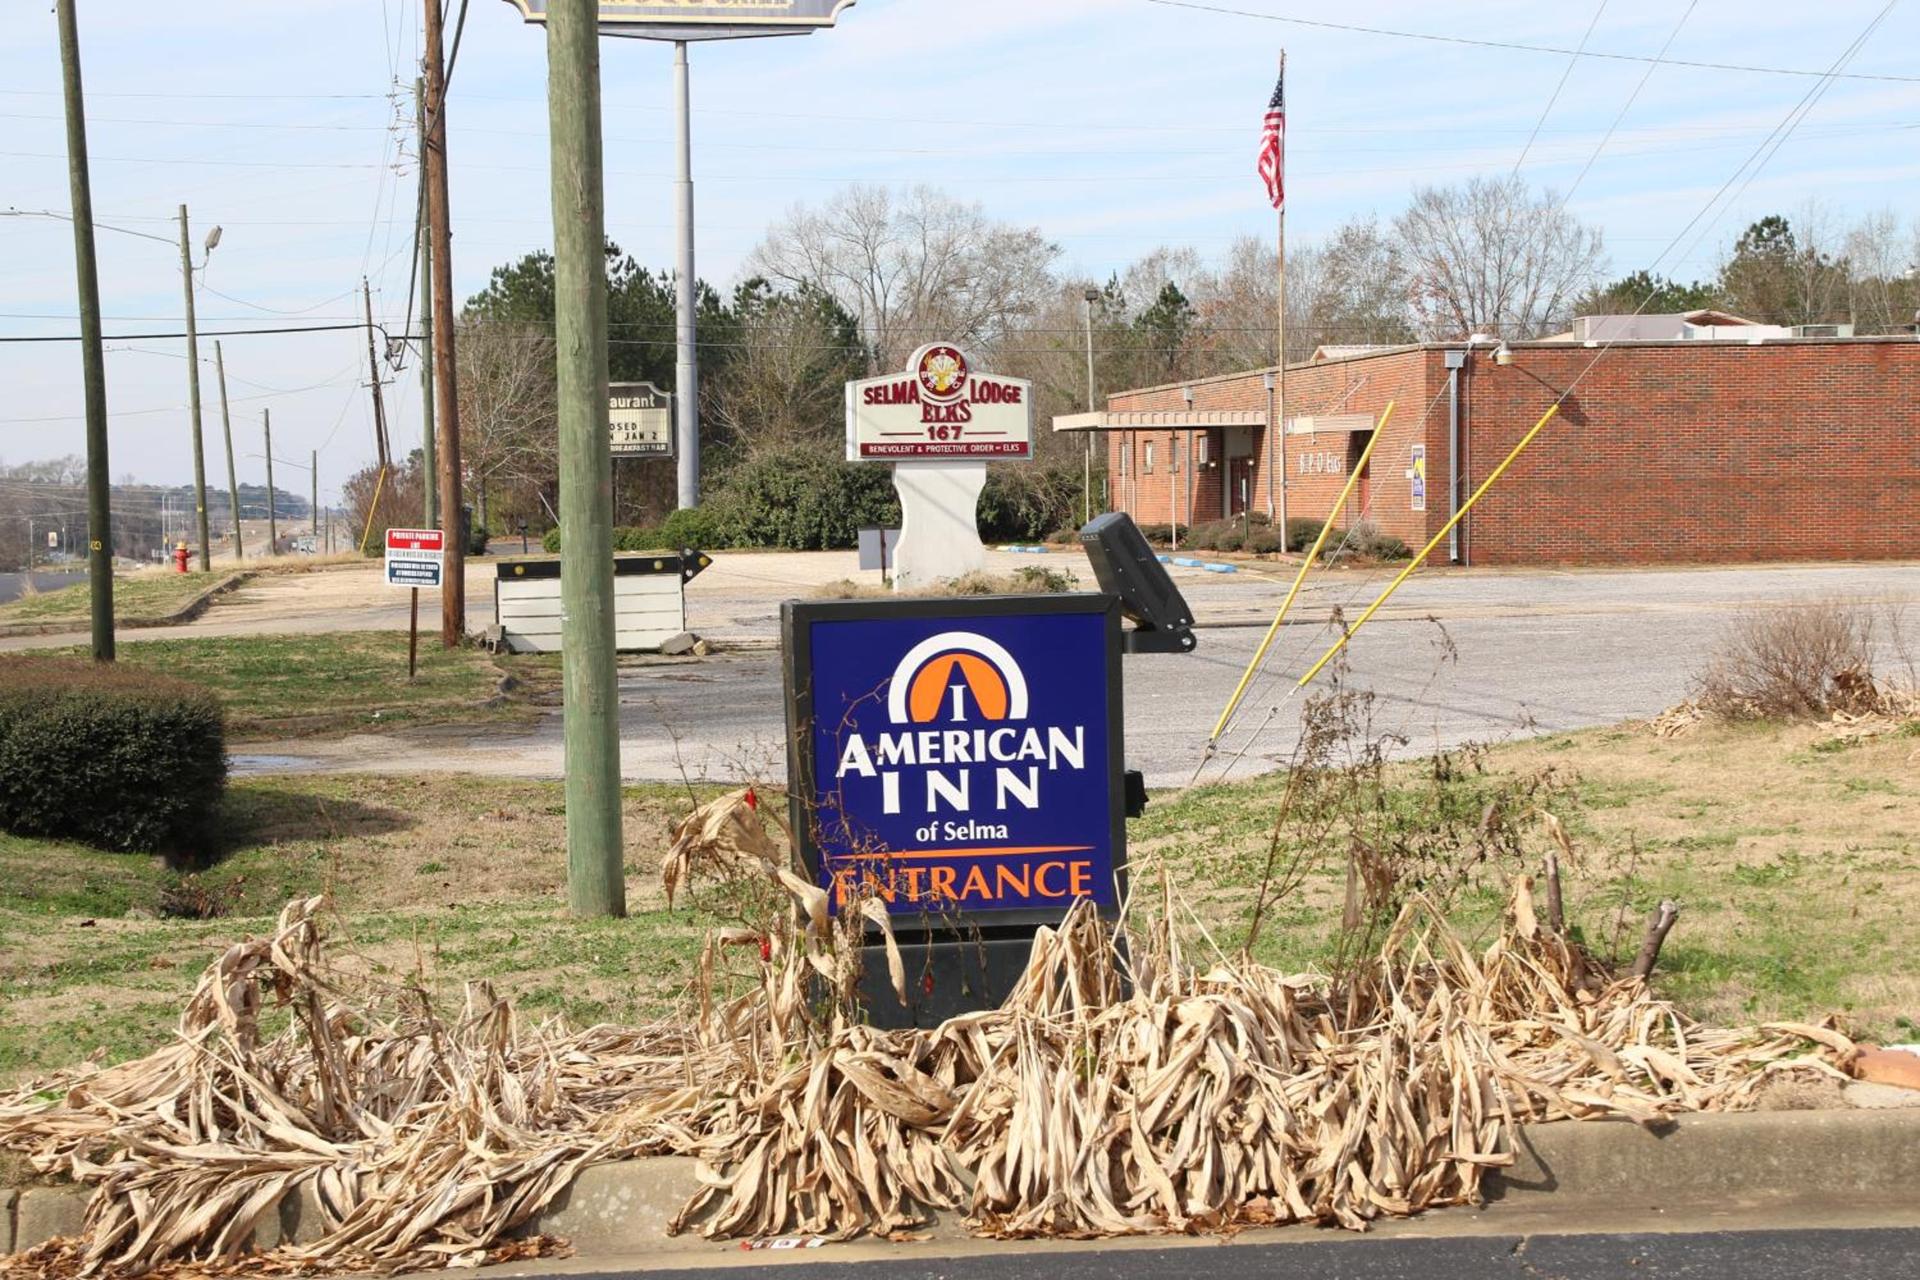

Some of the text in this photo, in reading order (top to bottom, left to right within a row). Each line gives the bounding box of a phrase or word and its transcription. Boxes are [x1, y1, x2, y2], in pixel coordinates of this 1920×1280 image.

[864, 379, 1023, 404] SELMA LODGE
[920, 399, 973, 423] ELKS
[625, 432, 645, 441] JAN
[927, 425, 963, 440] 167
[868, 445, 915, 453] BENEVOLENT
[925, 445, 967, 453] PROTECTIVE
[970, 444, 994, 453] ORDER
[1002, 443, 1020, 452] ELKS
[835, 726, 1085, 778] AMERICAN
[882, 766, 1039, 814] INN
[915, 819, 1009, 842] of Selma
